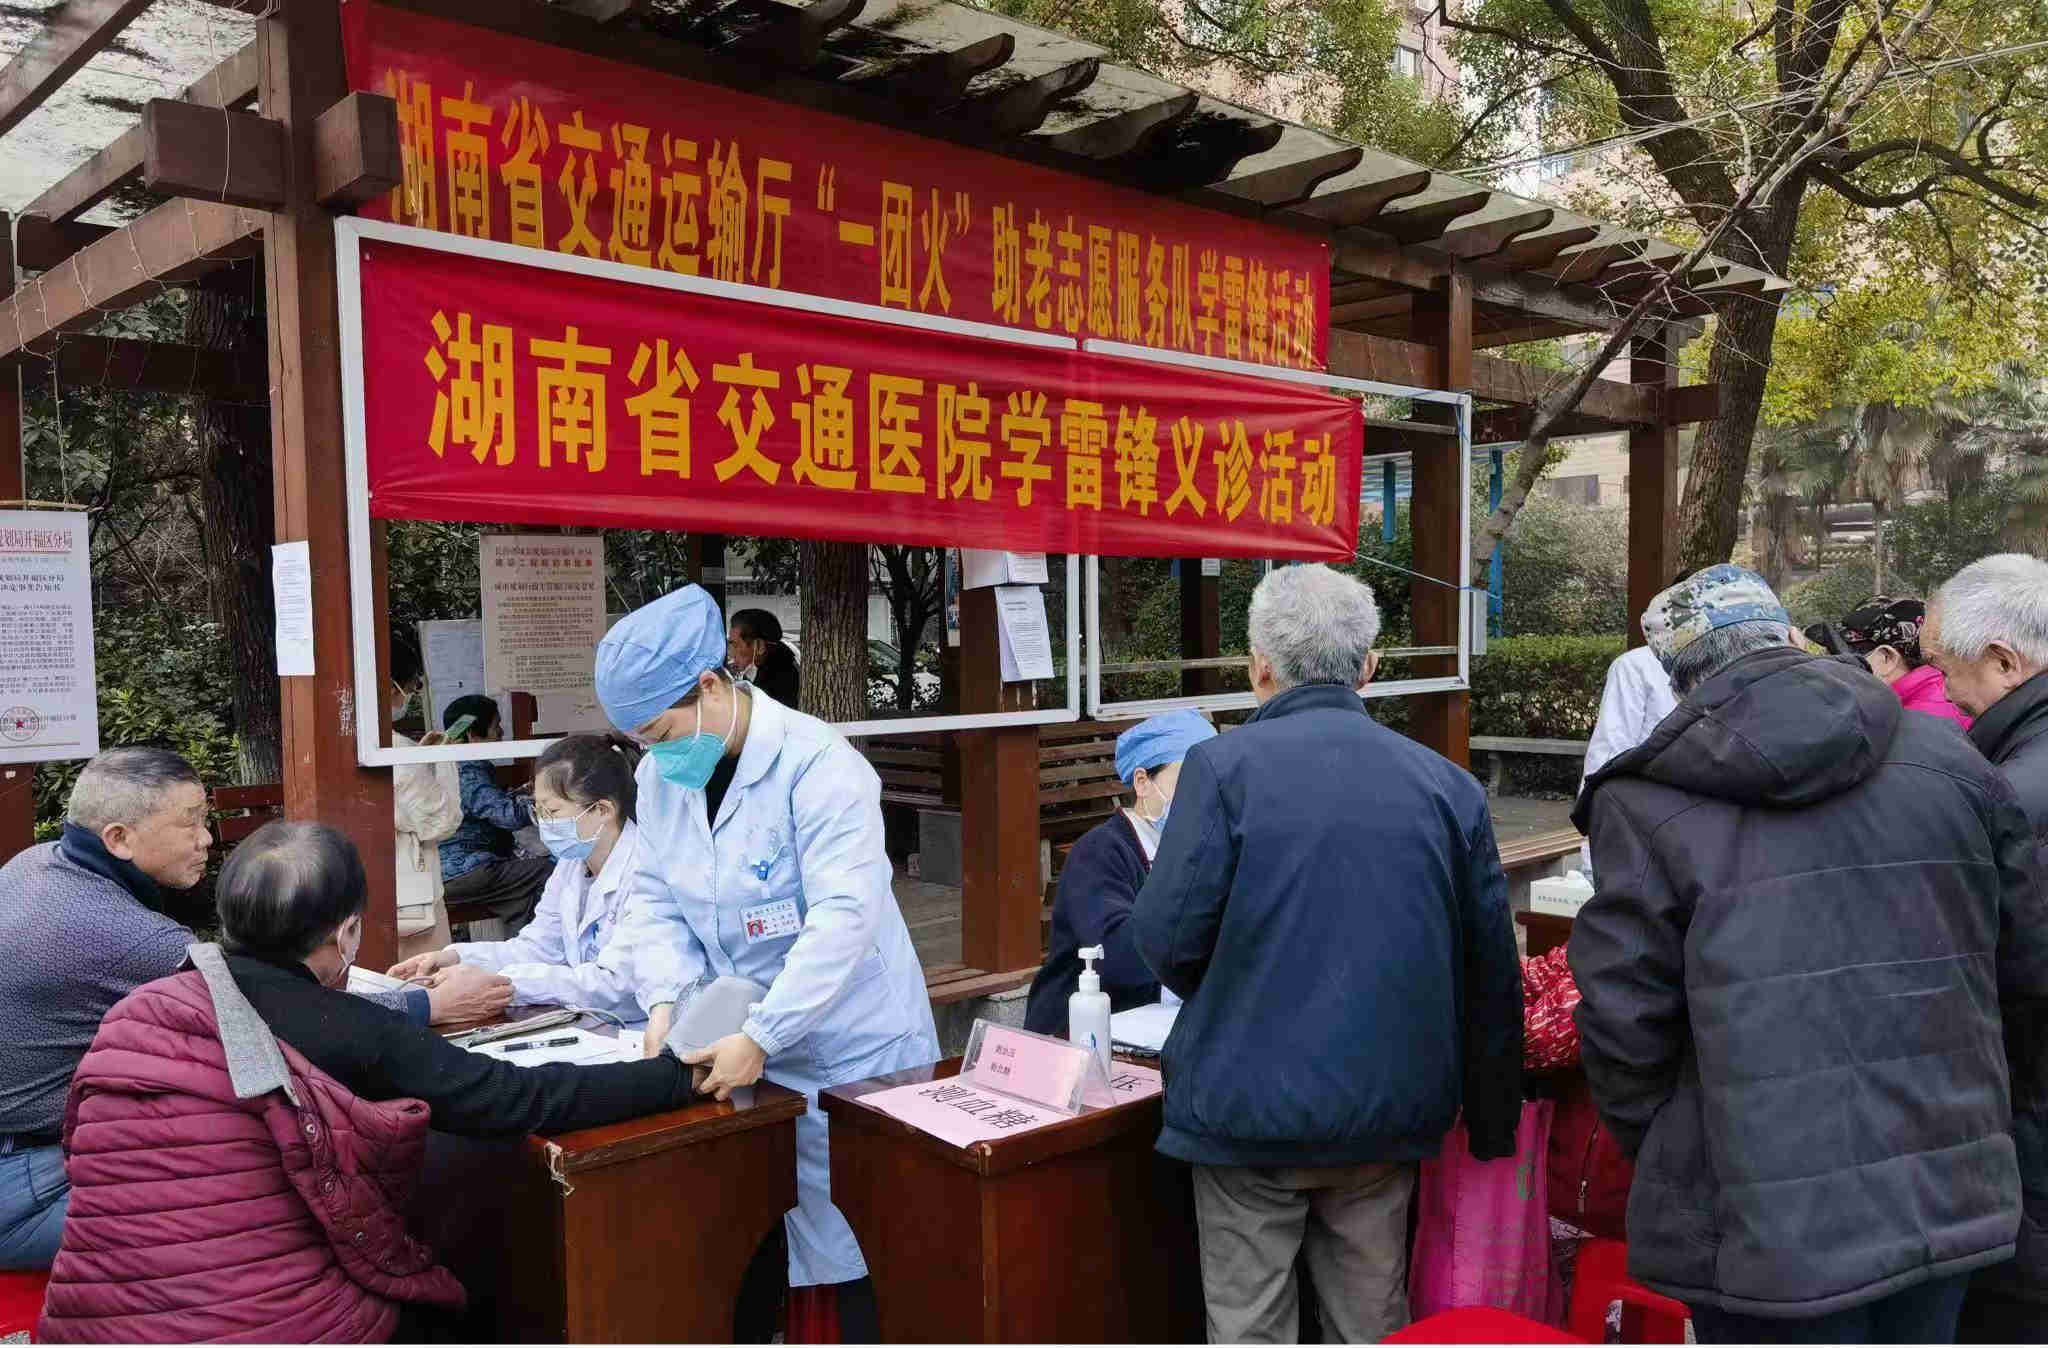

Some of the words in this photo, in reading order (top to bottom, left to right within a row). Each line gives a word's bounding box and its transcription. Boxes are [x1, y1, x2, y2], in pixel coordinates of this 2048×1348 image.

[424, 309, 1336, 526] 湖南省交通医院学雷锋义诊活动
[919, 1084, 1039, 1129] 测血糖
